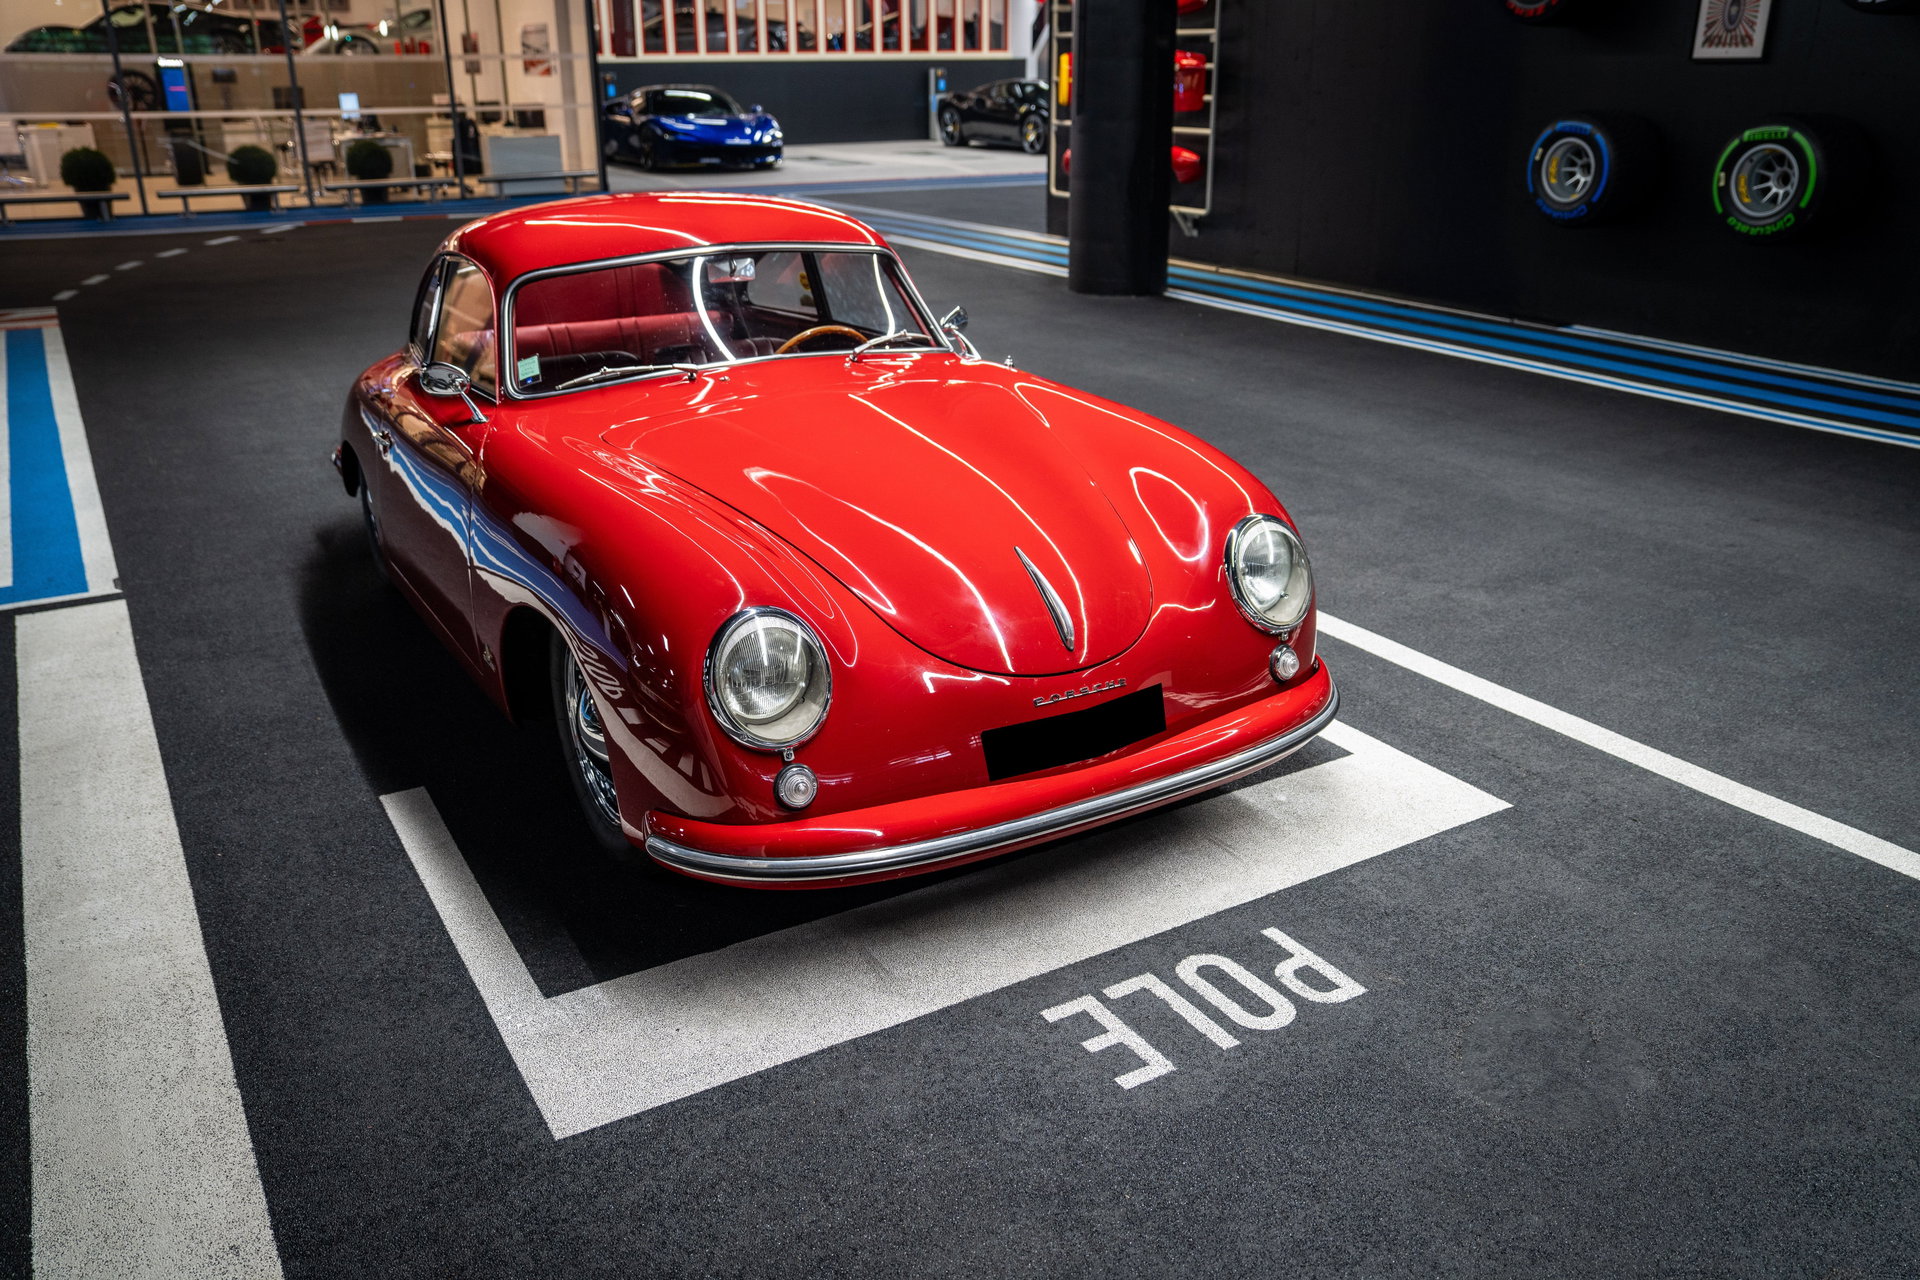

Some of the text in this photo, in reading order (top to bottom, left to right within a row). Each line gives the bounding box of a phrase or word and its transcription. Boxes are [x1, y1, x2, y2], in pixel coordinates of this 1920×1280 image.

[1726, 212, 1796, 235] Cinturato
[1033, 678, 1127, 706] PORSCHE
[1040, 926, 1369, 1090] POLE
